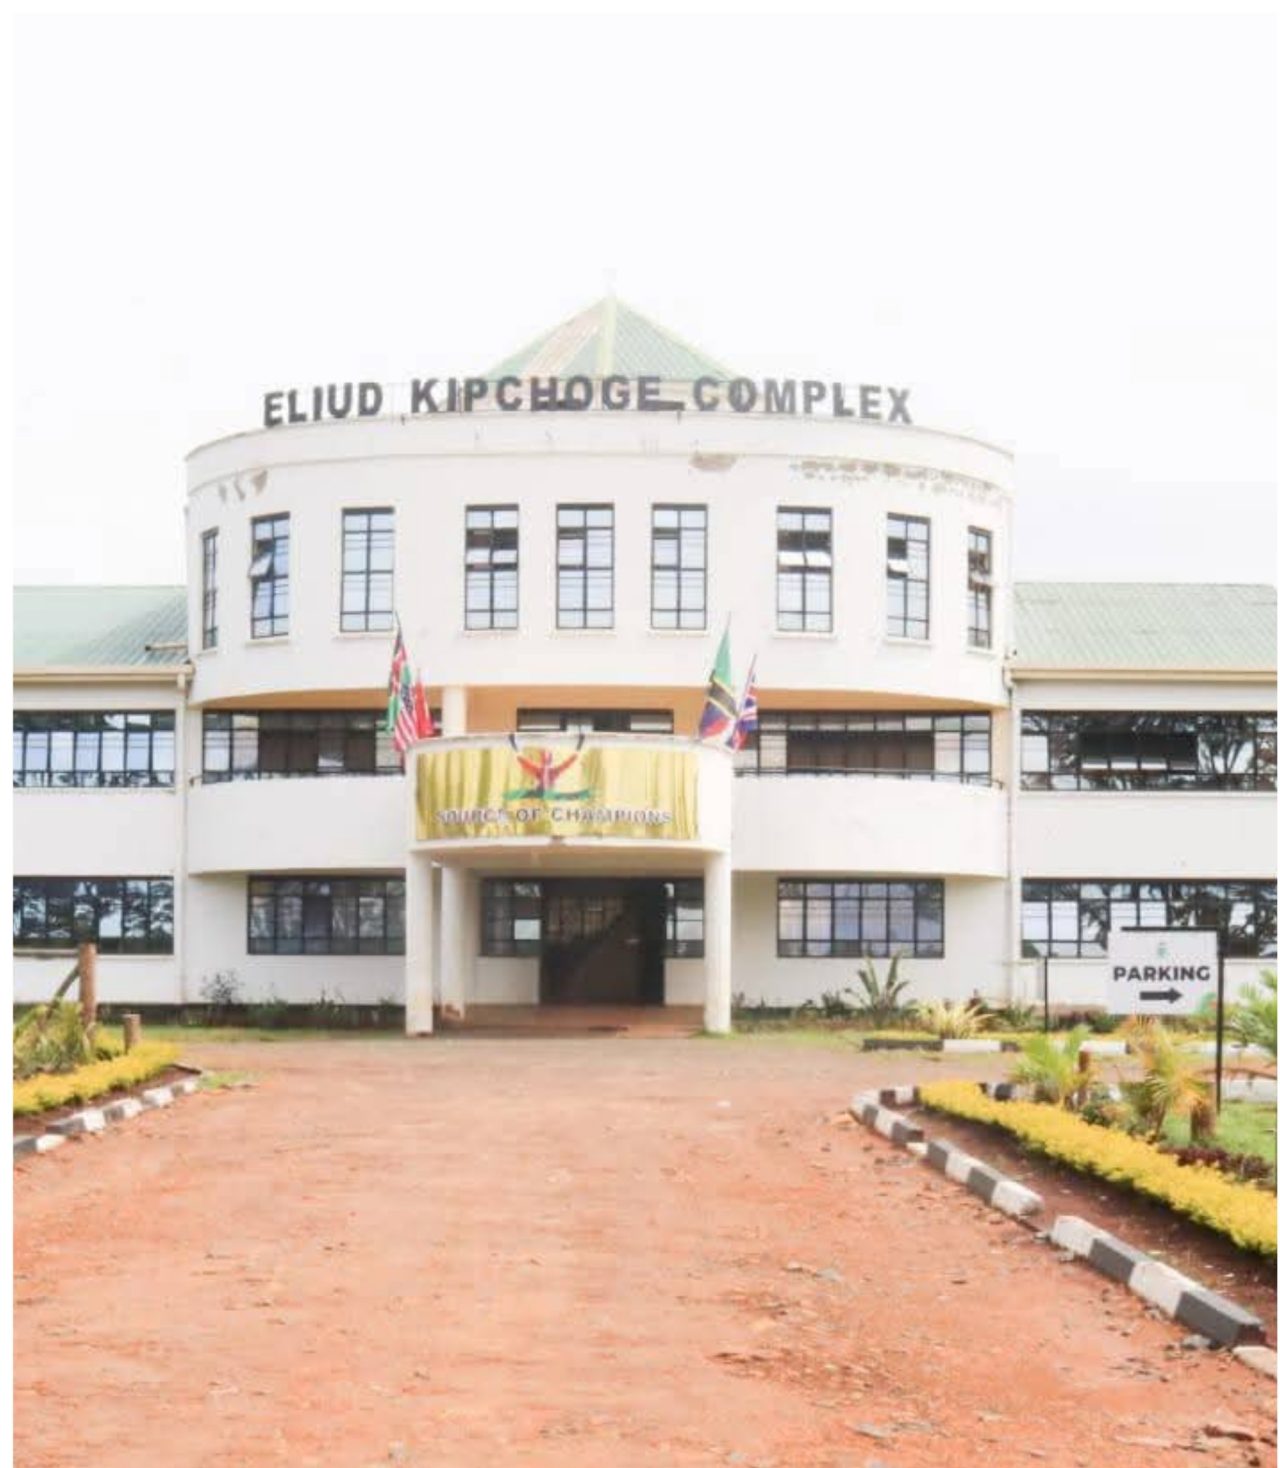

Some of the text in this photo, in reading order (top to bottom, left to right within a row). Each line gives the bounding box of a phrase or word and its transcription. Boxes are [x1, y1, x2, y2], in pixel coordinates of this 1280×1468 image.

[264, 374, 912, 428] ELIUD KIPCHOGE COMPLEX
[516, 808, 541, 822] OF
[551, 807, 672, 824] CHAMPIONS
[1113, 965, 1211, 981] PARKING
